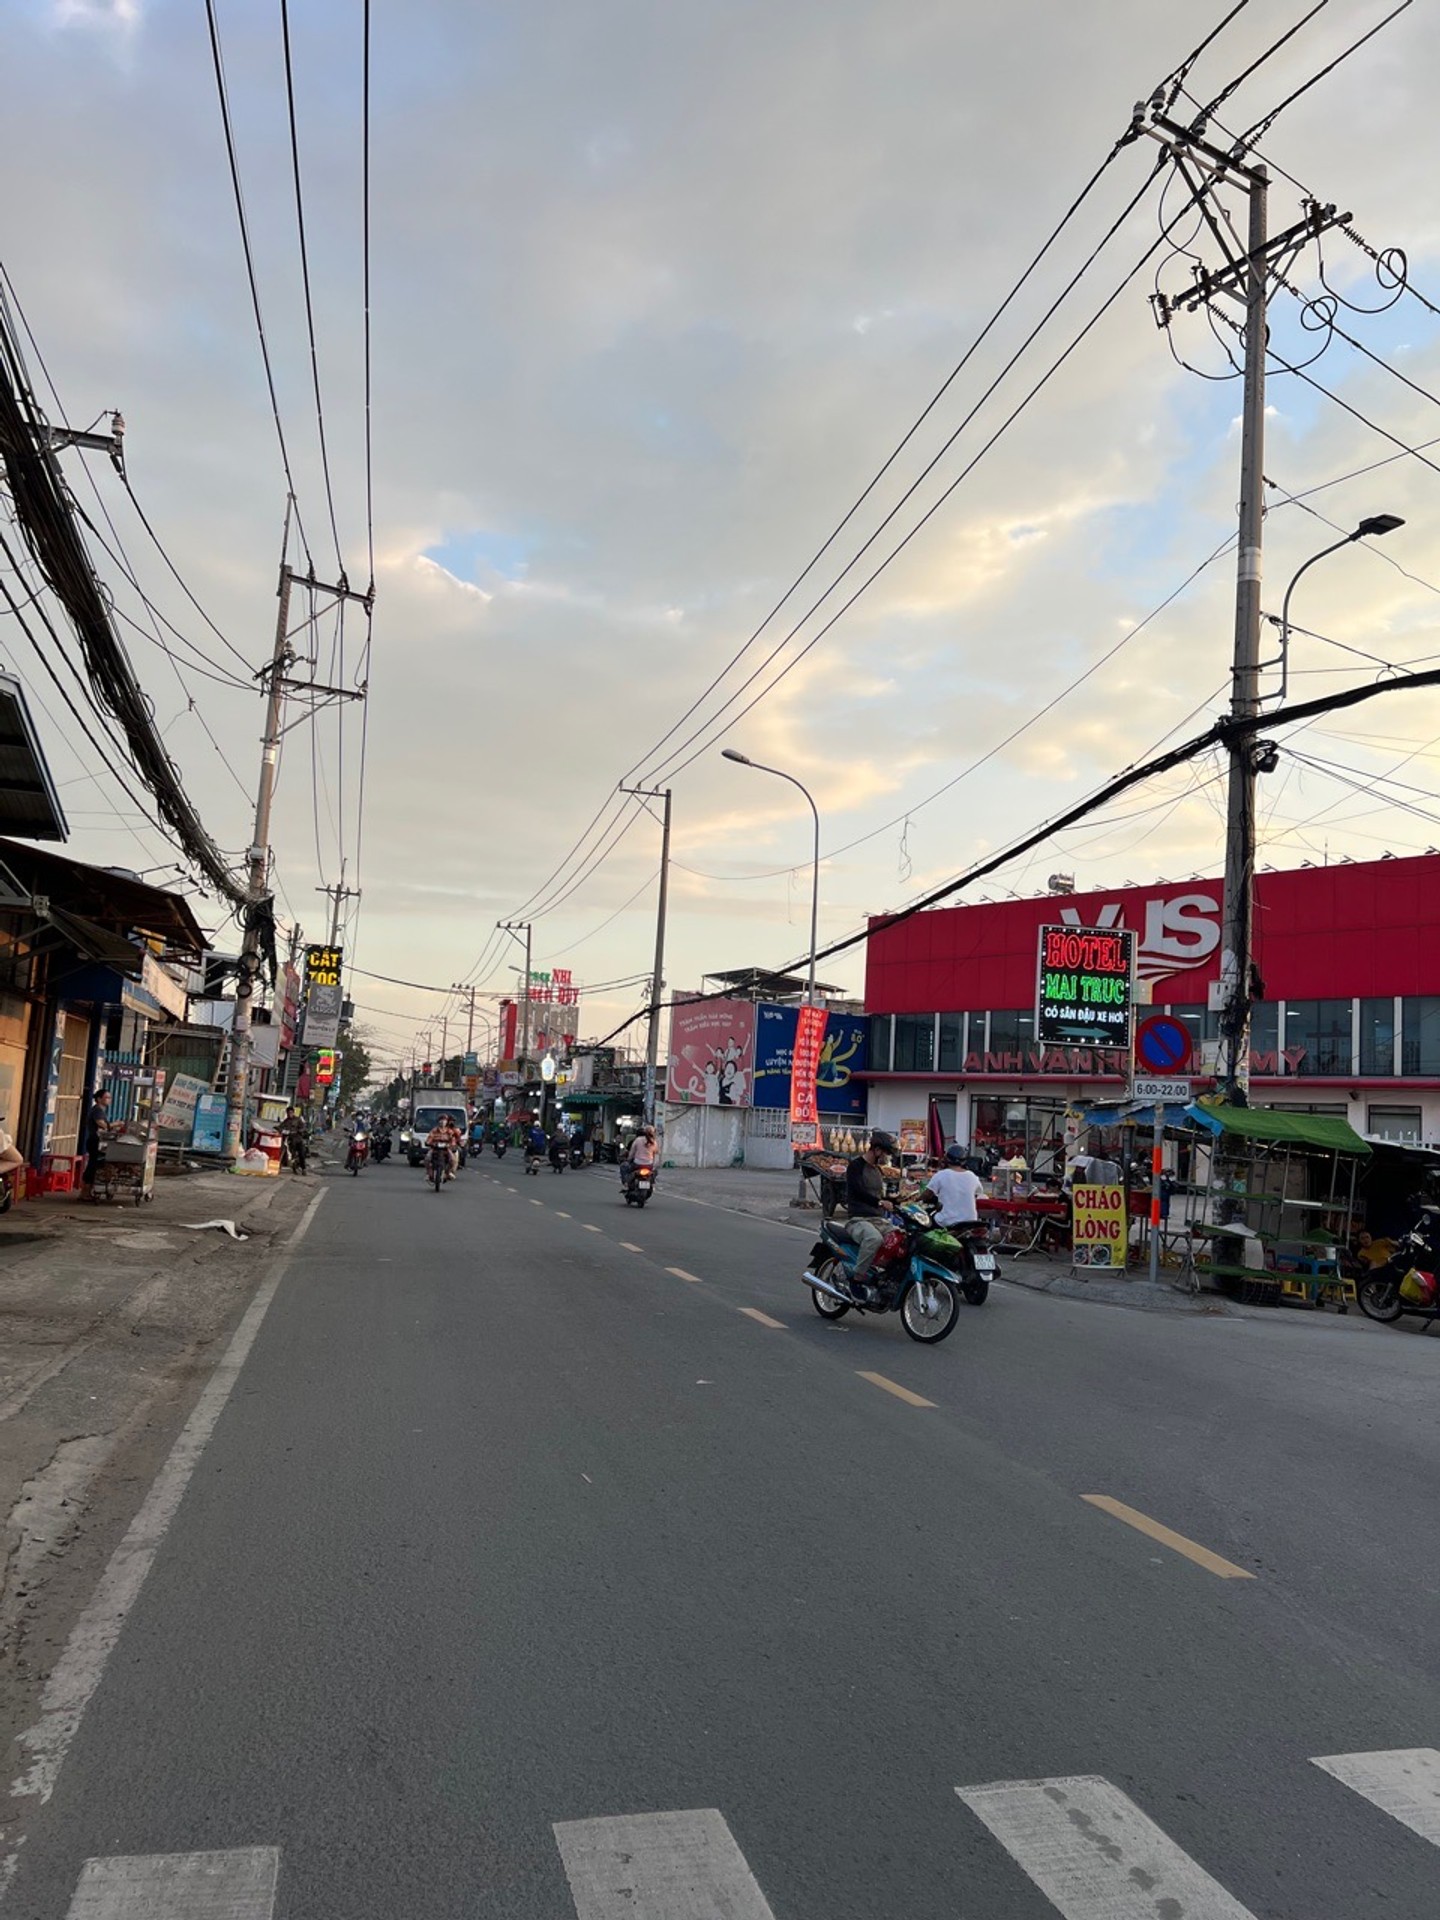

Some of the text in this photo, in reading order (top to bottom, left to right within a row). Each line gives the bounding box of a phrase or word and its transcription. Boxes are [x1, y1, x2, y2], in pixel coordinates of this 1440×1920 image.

[309, 946, 339, 967] CẮT
[1046, 932, 1126, 972] HOTEL
[1045, 974, 1078, 1001] MAI
[1045, 1004, 1059, 1018] CÓ
[1096, 1010, 1108, 1022] XE
[963, 1051, 1023, 1072] ANH
[1029, 1047, 1089, 1073] VĂN
[1249, 1046, 1306, 1073] MỸ
[1074, 1186, 1122, 1211] CHÁO
[1074, 1213, 1122, 1240] LÒNG
